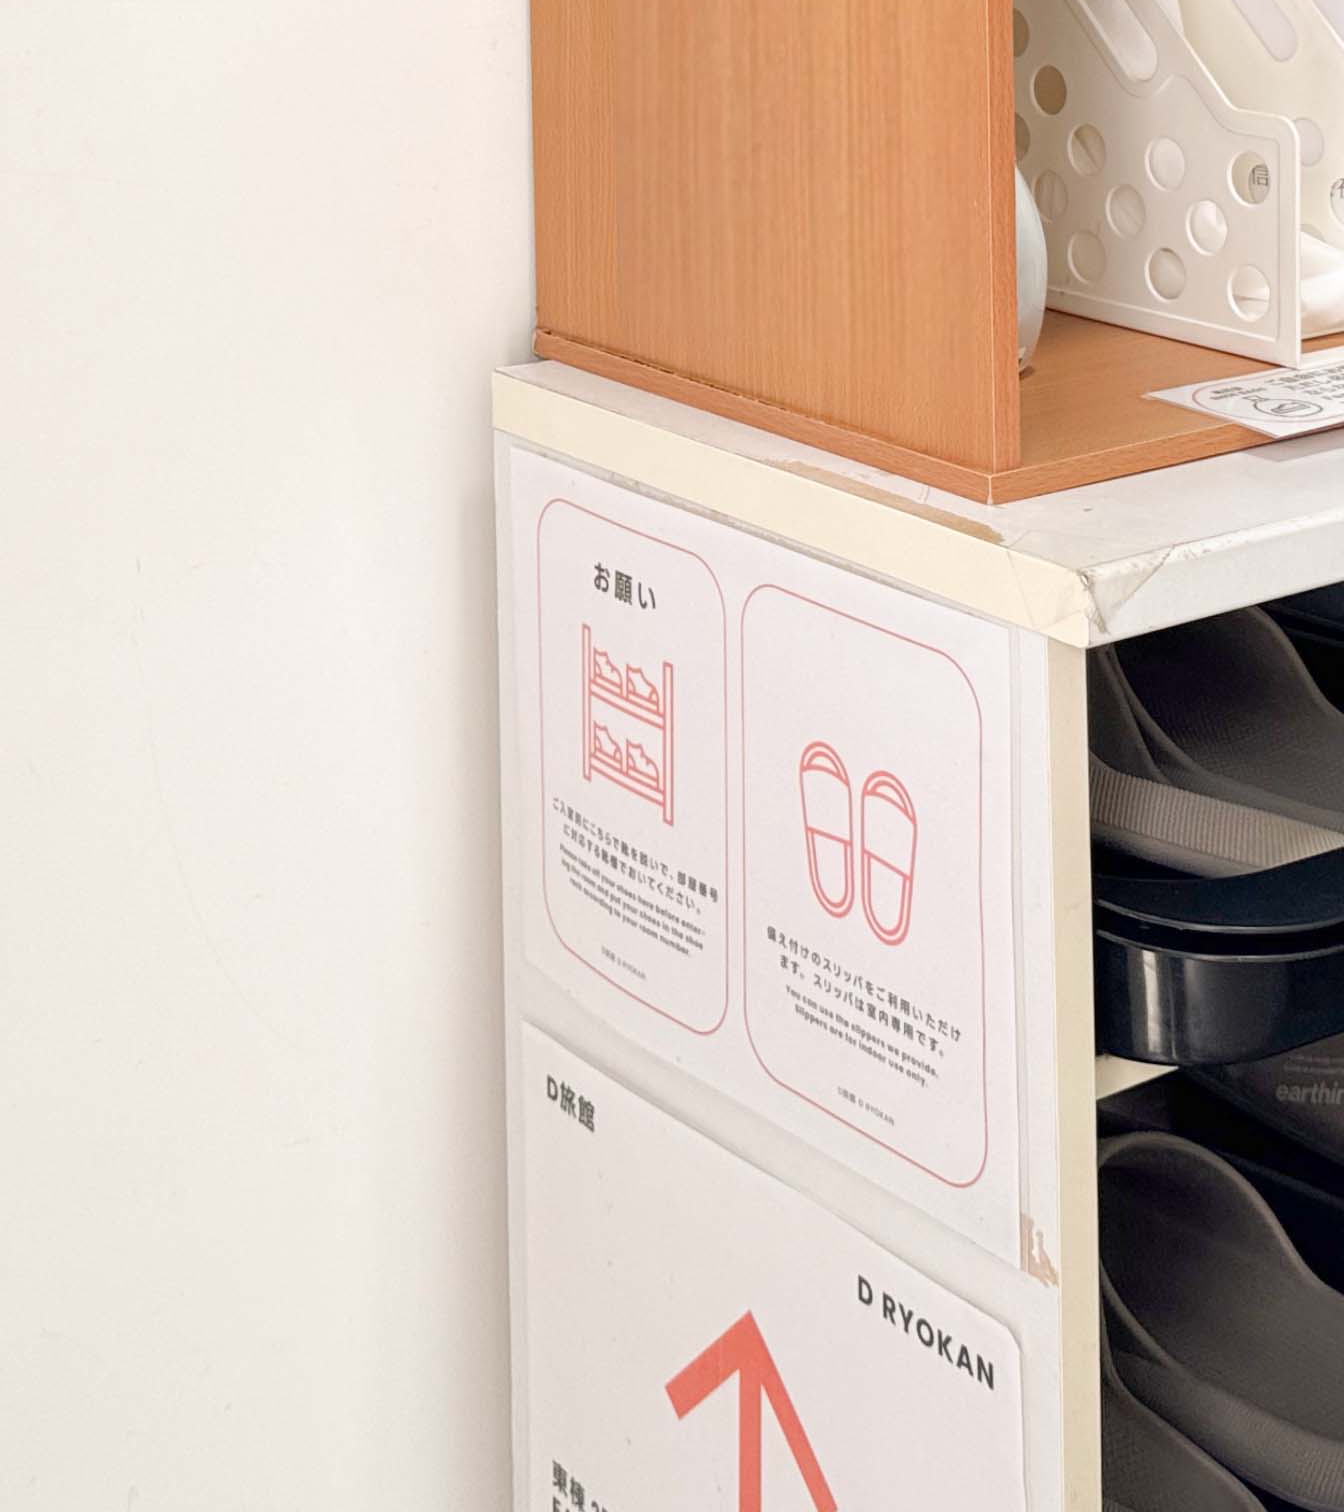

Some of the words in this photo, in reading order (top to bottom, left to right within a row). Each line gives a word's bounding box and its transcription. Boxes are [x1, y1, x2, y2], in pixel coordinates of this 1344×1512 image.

[593, 561, 657, 610] お願い
[766, 924, 961, 1043] 備え付けのスリッパをご利用いただけ
[829, 1025, 843, 1039] are
[844, 1030, 857, 1046] for
[858, 1039, 887, 1064] indoor
[888, 1057, 904, 1073] use
[835, 1009, 849, 1028] the
[850, 1020, 885, 1050] slippers
[887, 1042, 900, 1056] we
[547, 1074, 595, 1133] D旅館
[858, 1274, 873, 1306] D
[882, 1290, 995, 1391] RYOKAN
